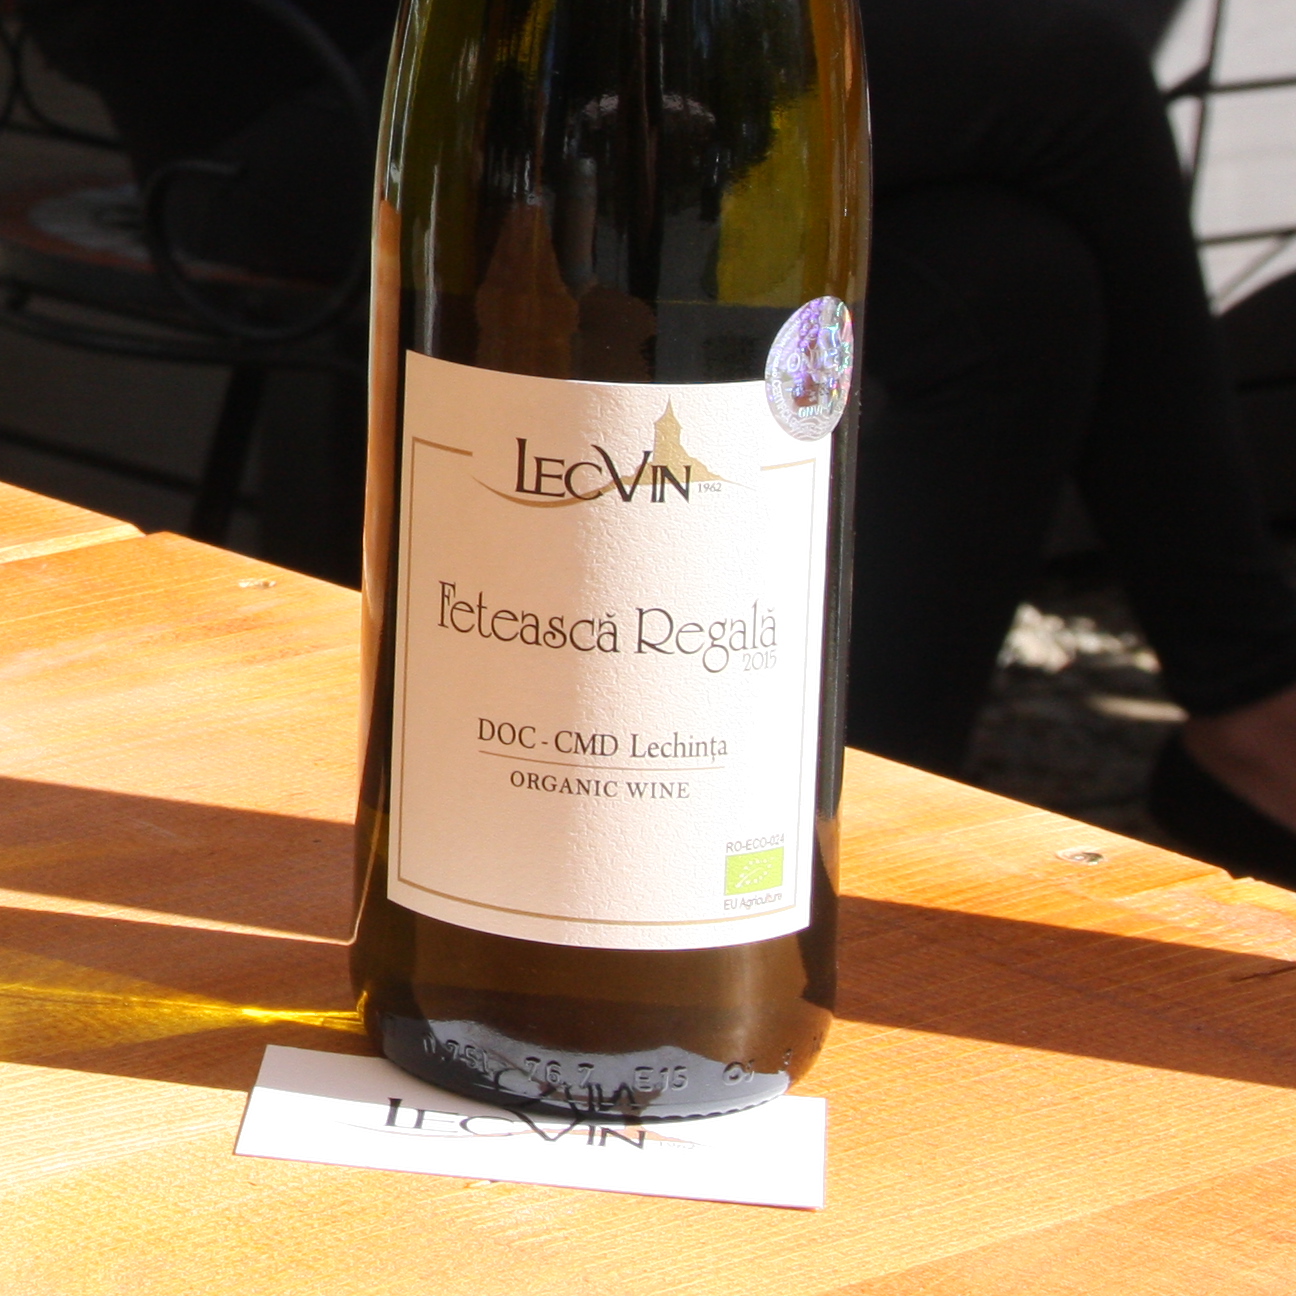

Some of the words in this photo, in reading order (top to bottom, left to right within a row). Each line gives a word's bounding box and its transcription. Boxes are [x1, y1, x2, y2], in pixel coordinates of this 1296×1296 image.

[697, 482, 722, 493] 1962
[437, 580, 621, 654] Fetească
[635, 598, 777, 673] Regală
[742, 649, 777, 672] 2015
[510, 770, 618, 798] ORGANIC
[626, 781, 690, 800] WINE
[725, 833, 785, 853] RO-ECO-024
[723, 899, 738, 911] EU
[740, 891, 783, 910] Agriculture
